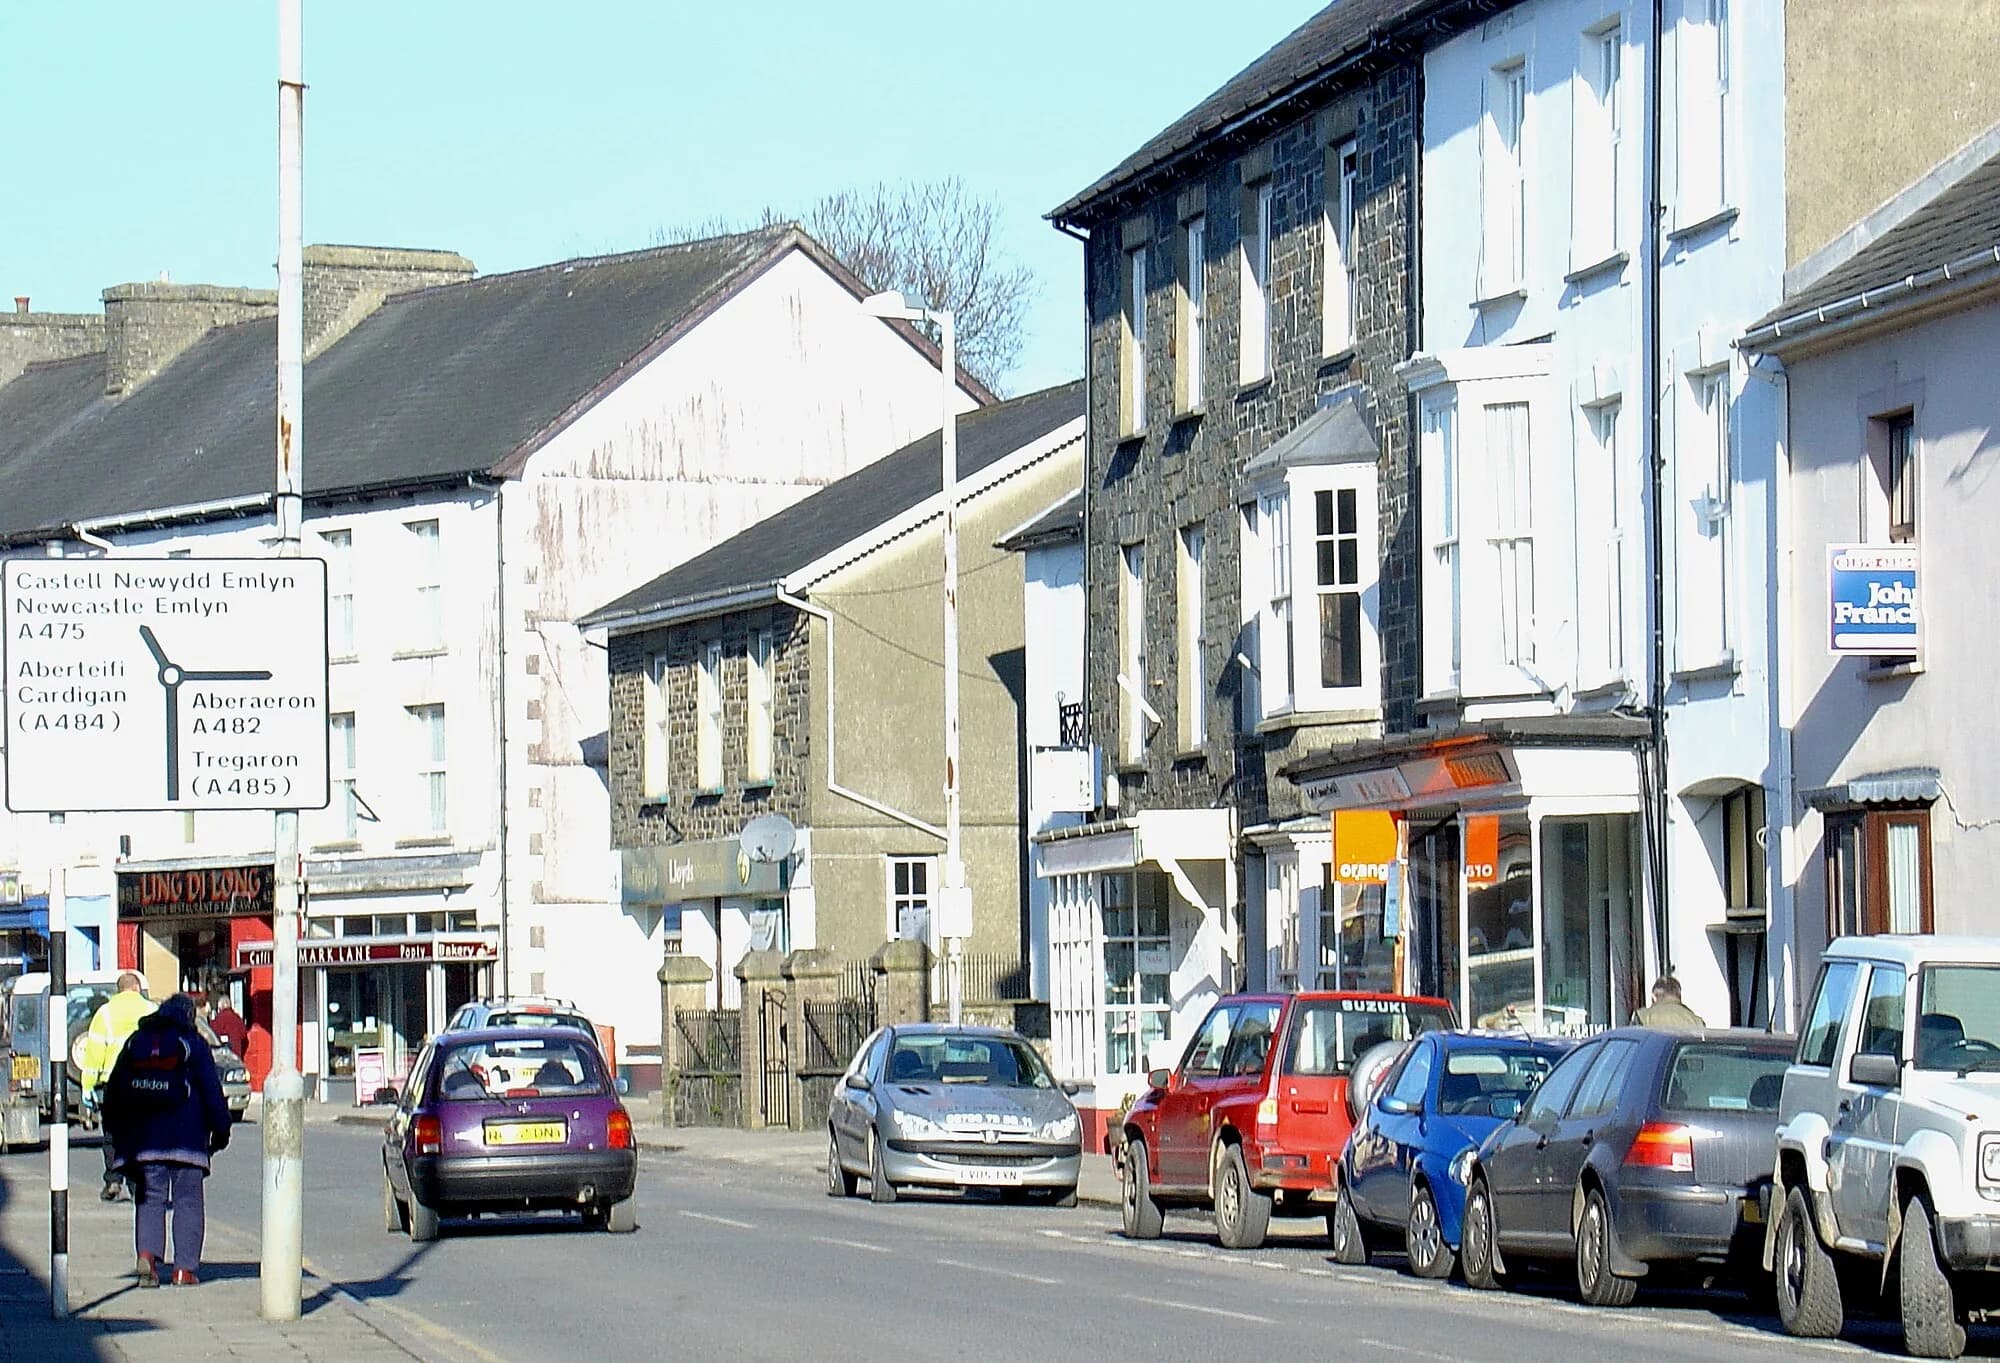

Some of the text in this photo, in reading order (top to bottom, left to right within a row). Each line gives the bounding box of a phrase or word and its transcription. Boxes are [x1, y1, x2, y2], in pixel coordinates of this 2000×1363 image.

[16, 572, 295, 592] Castell Newydd Emlyn
[16, 597, 229, 617] Newcastle Emlyn
[18, 623, 85, 640] A475
[18, 661, 126, 678] Aberteifi
[18, 686, 127, 706] Cardigan
[192, 693, 316, 710] Aberaeron
[19, 711, 121, 732] (A484)
[192, 717, 262, 735] A482
[192, 751, 299, 771] Tregaron
[192, 776, 292, 797] (A485)
[1340, 864, 1389, 880] orang
[140, 872, 182, 906] LING
[210, 867, 262, 903] LONG
[299, 946, 334, 964] MARK
[339, 945, 370, 962] LANE
[1342, 1000, 1406, 1014] SUZUKI
